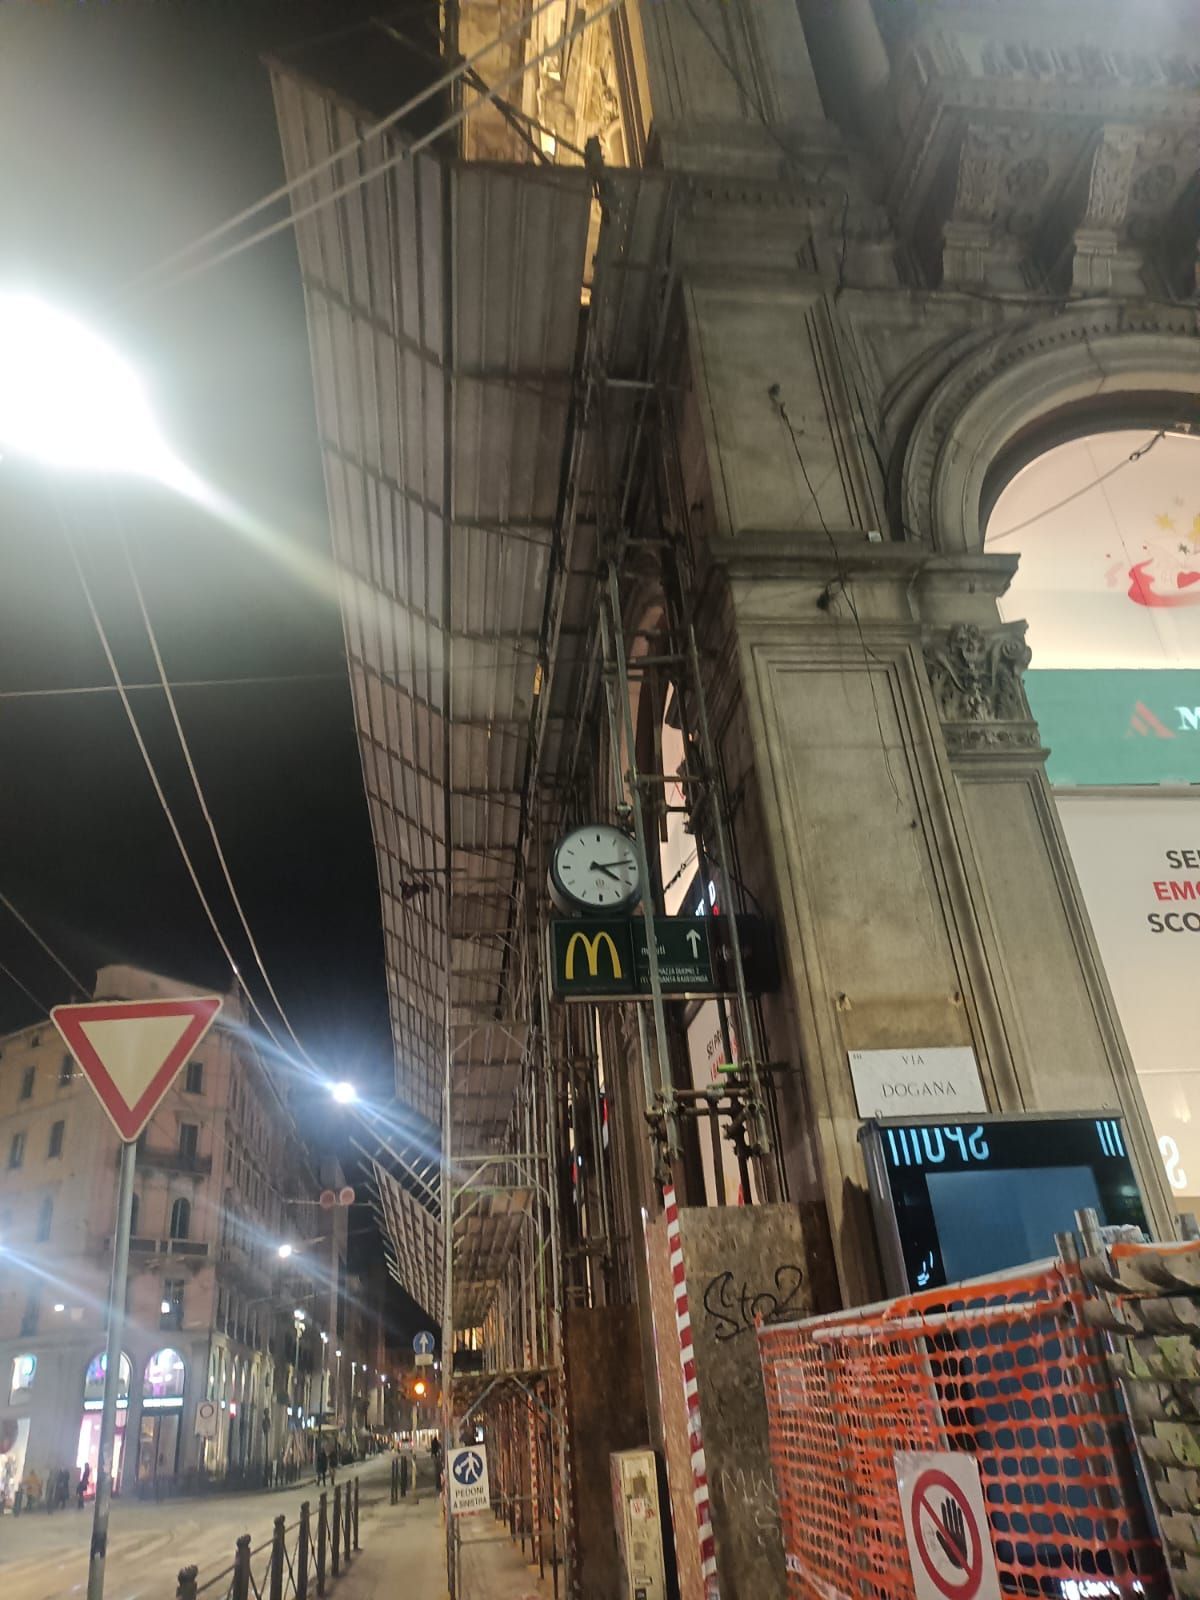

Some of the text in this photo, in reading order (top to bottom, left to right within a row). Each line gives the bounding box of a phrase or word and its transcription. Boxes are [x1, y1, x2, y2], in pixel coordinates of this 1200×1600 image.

[1152, 881, 1200, 901] EM
[902, 1055, 925, 1065] VIA
[881, 1080, 957, 1099] DOGANA
